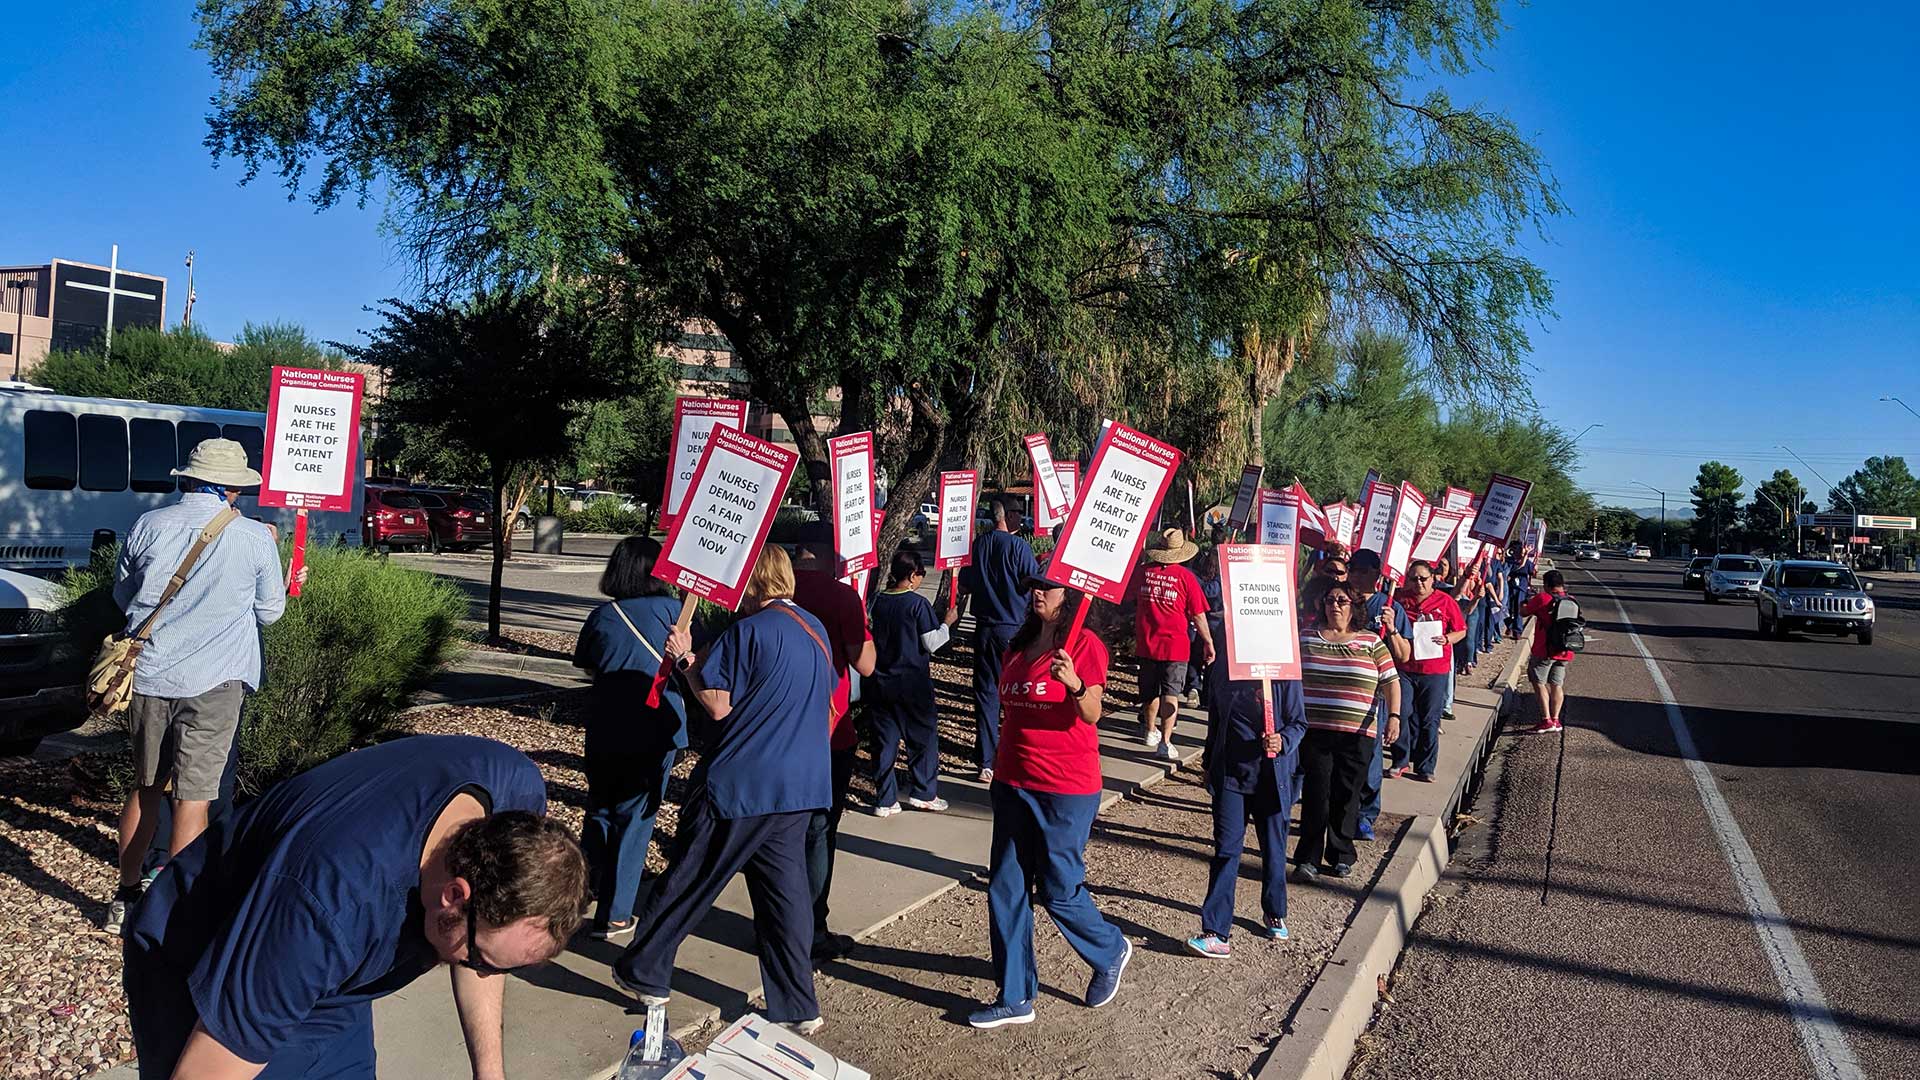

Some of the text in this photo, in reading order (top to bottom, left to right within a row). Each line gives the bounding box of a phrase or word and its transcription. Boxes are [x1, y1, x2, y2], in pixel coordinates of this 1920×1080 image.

[281, 369, 355, 384] National Nurses
[281, 378, 354, 390] Organizing Committee
[294, 404, 336, 416] NURSES
[682, 400, 739, 410] National Nurses
[290, 419, 336, 430] ARE THE
[285, 433, 339, 445] HEART OF
[720, 428, 788, 462] National Nurses
[836, 436, 868, 448] National Nurses
[1115, 428, 1175, 459] National Nurses
[288, 448, 334, 459] PATIENT
[716, 438, 785, 470] Organizing Committee
[1112, 436, 1171, 467] Organizing Committee
[294, 462, 322, 472] CARE
[846, 468, 862, 480] NURSES
[718, 470, 760, 494] NURSES
[1111, 469, 1147, 490] NURSES
[854, 483, 862, 491] THE
[708, 485, 756, 512] DEMAND
[844, 496, 865, 510] HEART OF
[1102, 485, 1142, 507] ARE THE
[708, 504, 743, 524] A FAIR
[846, 510, 864, 524] PATIENT
[1093, 500, 1139, 524] HEART OF
[692, 515, 748, 545] CONTRACT
[849, 526, 861, 537] CARE
[1090, 517, 1129, 538] PATIENT
[1267, 521, 1292, 529] STANDING
[1280, 532, 1290, 540] OUR
[698, 537, 728, 555] NOW
[1091, 536, 1116, 552] CARE
[1240, 584, 1280, 592] STANDING
[1243, 596, 1278, 605] FOR OUR
[1001, 682, 1047, 695] URSE
